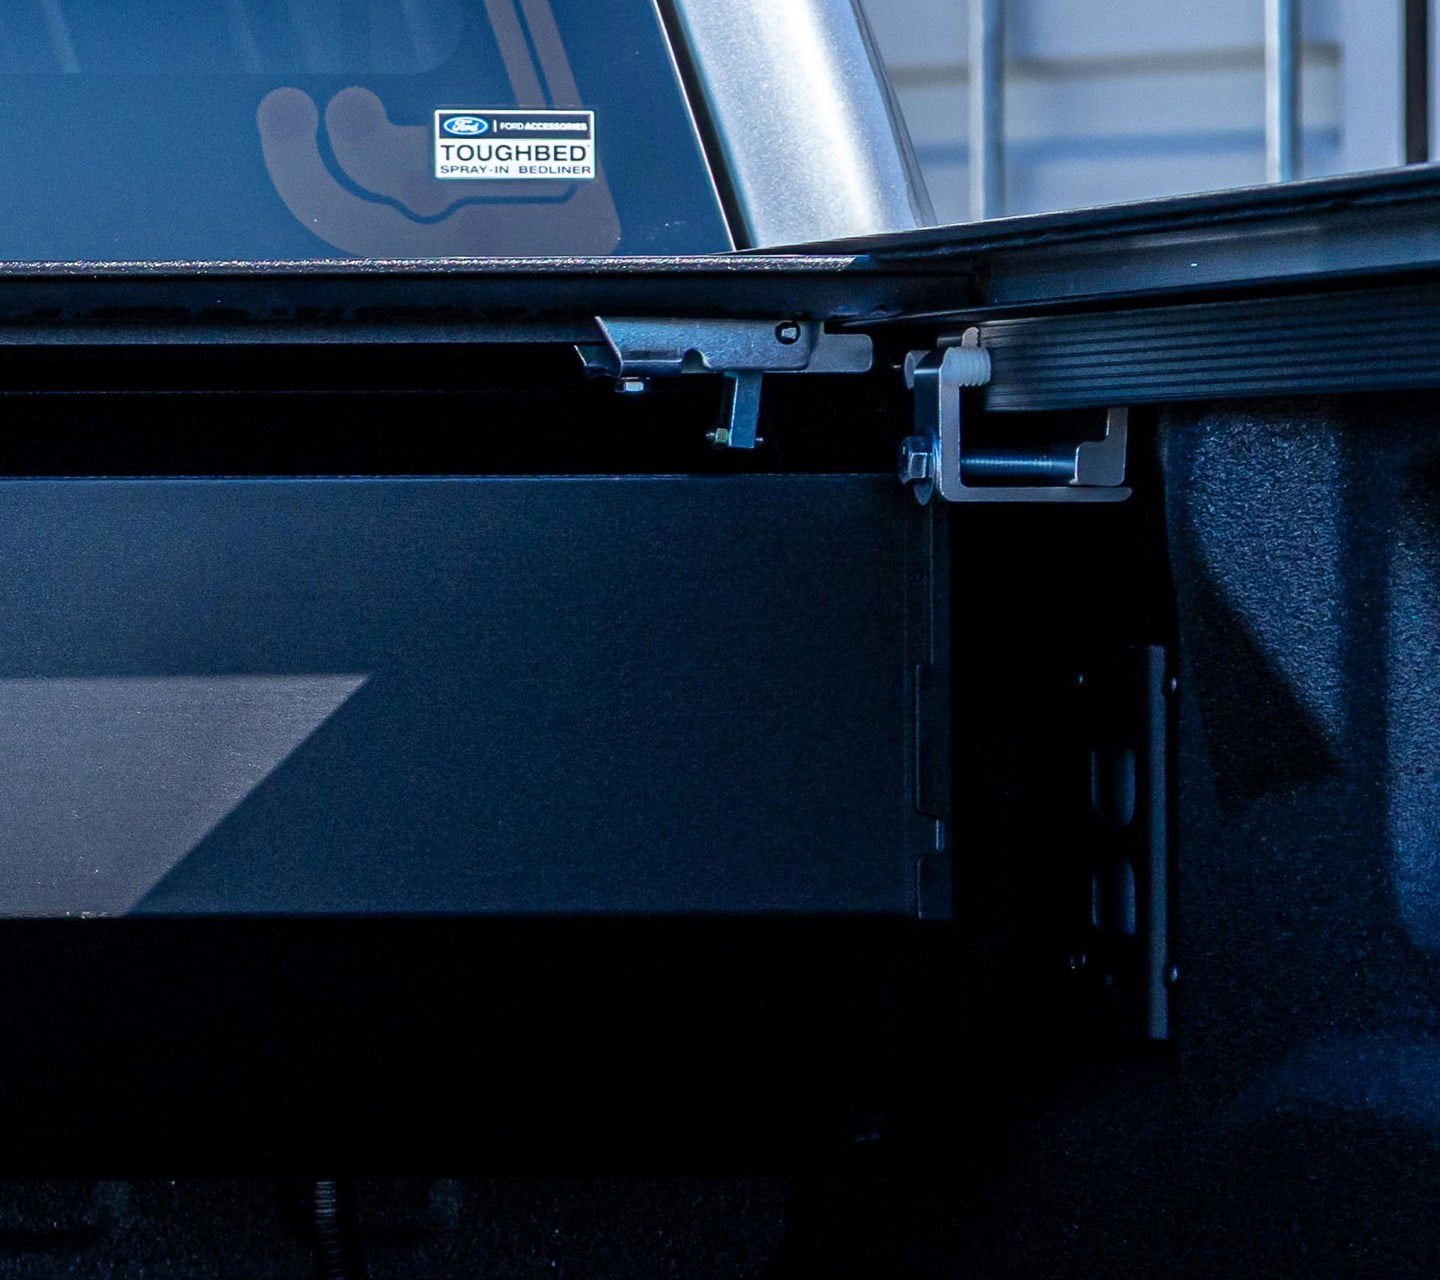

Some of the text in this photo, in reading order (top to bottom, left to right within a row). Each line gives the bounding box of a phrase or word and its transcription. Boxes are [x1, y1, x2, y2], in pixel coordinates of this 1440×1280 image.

[500, 122, 588, 131] FORD ACCESSORIES
[440, 144, 587, 162] TOUGHBED
[440, 165, 591, 174] SPRAY-IN BEDLINER
